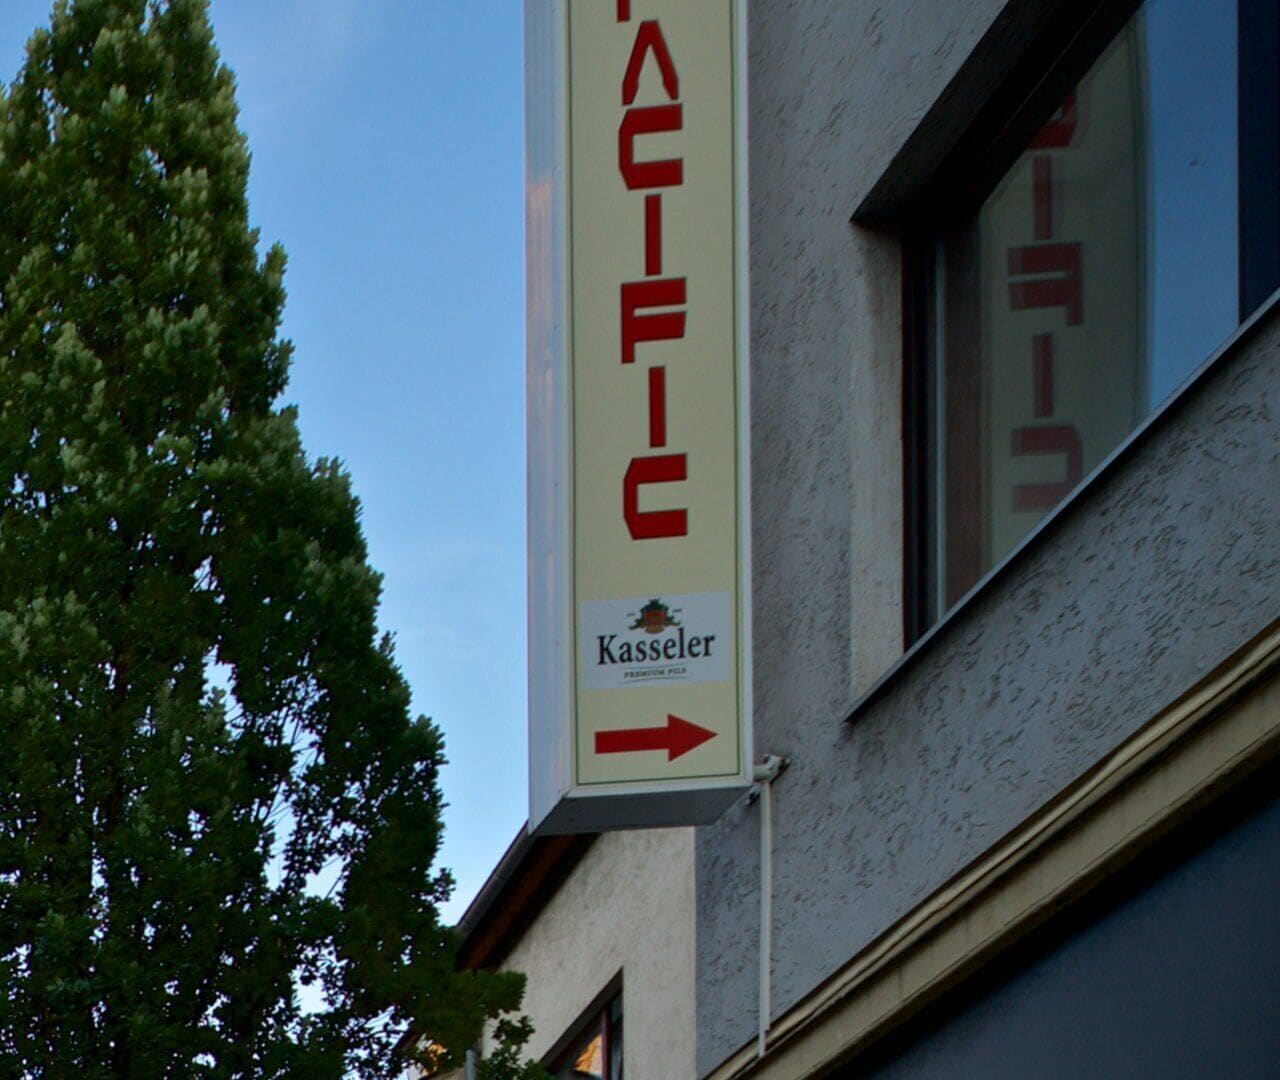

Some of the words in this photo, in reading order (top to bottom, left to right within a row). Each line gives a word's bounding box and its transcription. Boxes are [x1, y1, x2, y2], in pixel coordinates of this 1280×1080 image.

[616, 0, 689, 541] ACIFIC
[596, 627, 716, 665] Kasseler
[624, 669, 666, 679] PREMIUM
